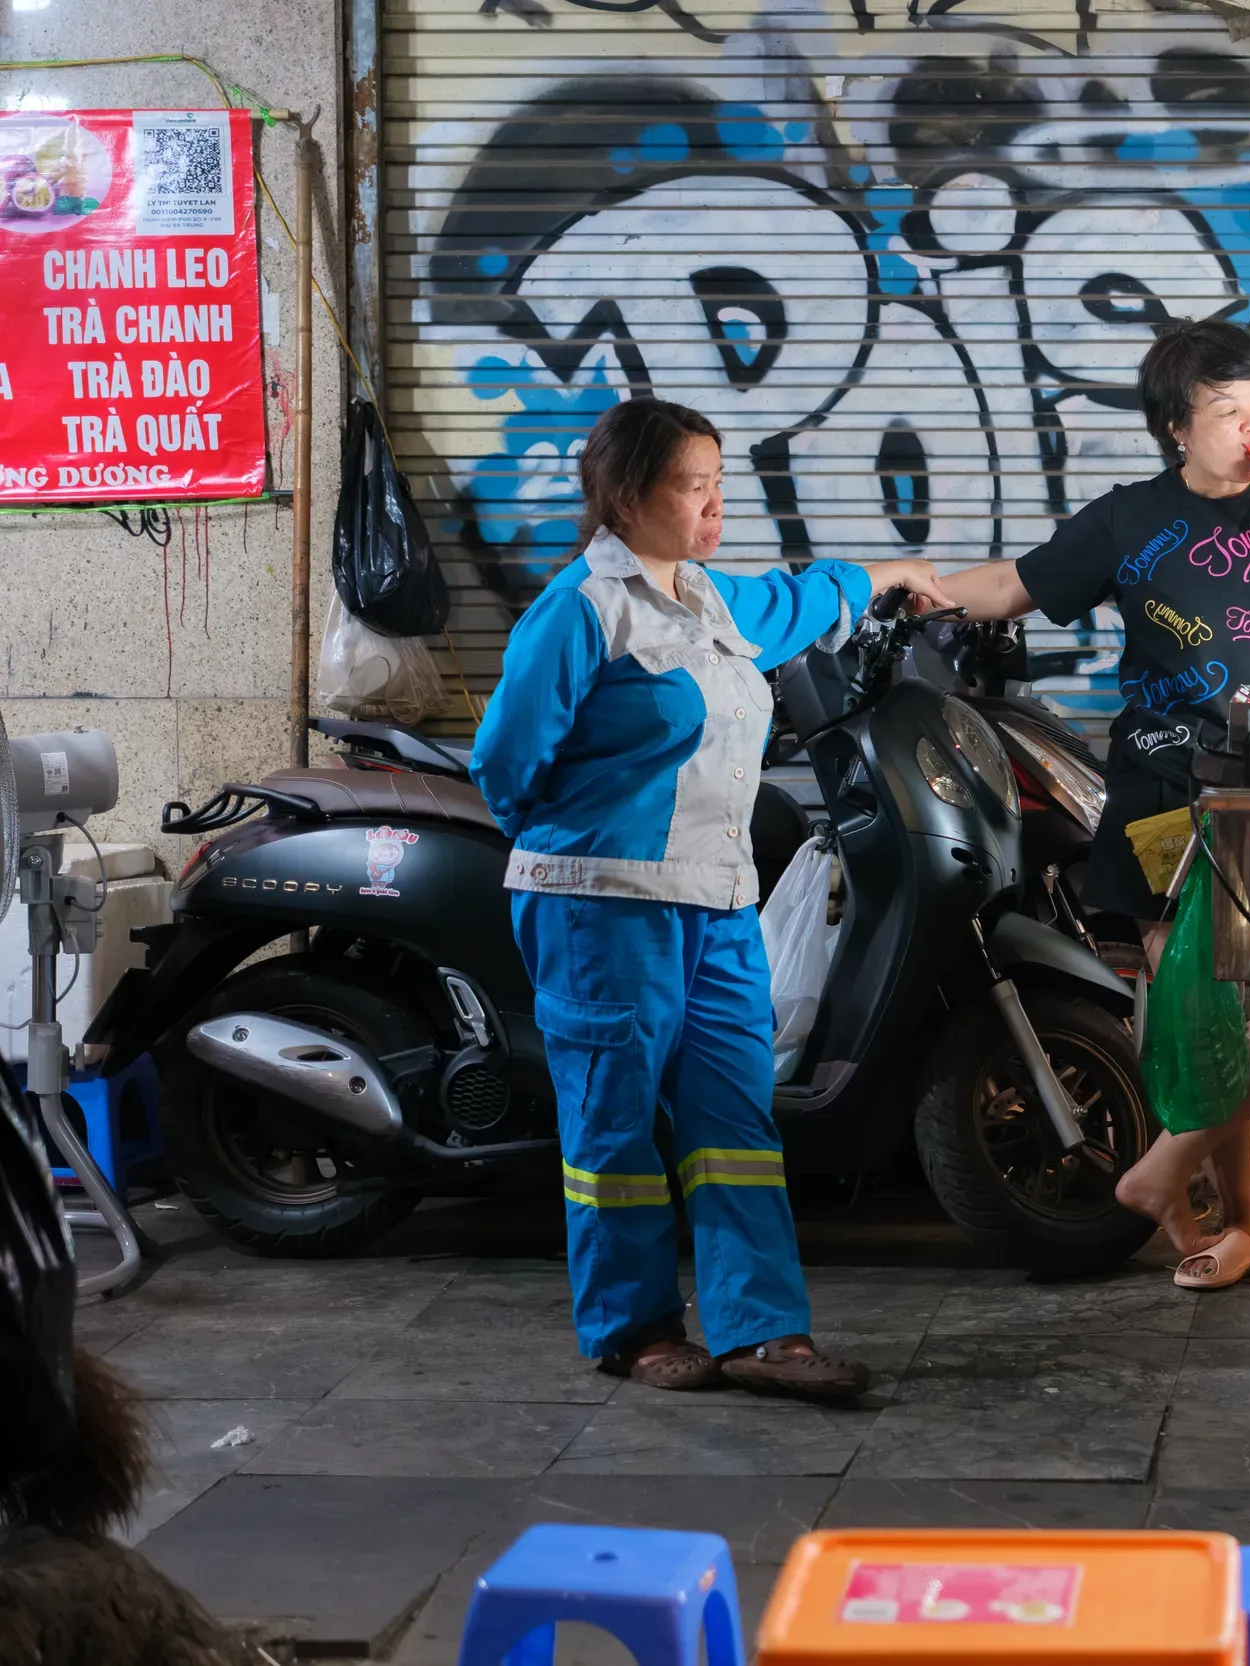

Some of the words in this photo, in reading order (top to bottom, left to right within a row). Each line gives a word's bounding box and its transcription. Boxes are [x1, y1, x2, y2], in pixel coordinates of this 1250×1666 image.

[44, 249, 156, 290] CHANH
[167, 248, 229, 288] LEO
[43, 299, 105, 345] TRÀ
[115, 305, 233, 344] CHANH
[68, 352, 133, 399] TRÀ
[142, 352, 210, 398] ĐÀO
[62, 407, 128, 453] TRÀ
[137, 400, 222, 456] QUẤT
[57, 462, 172, 487] DƯƠNG
[1117, 519, 1188, 585] Tommy
[1145, 599, 1213, 649] Tommy
[1127, 725, 1190, 755] Tommy
[222, 877, 342, 894] SCOOPY
